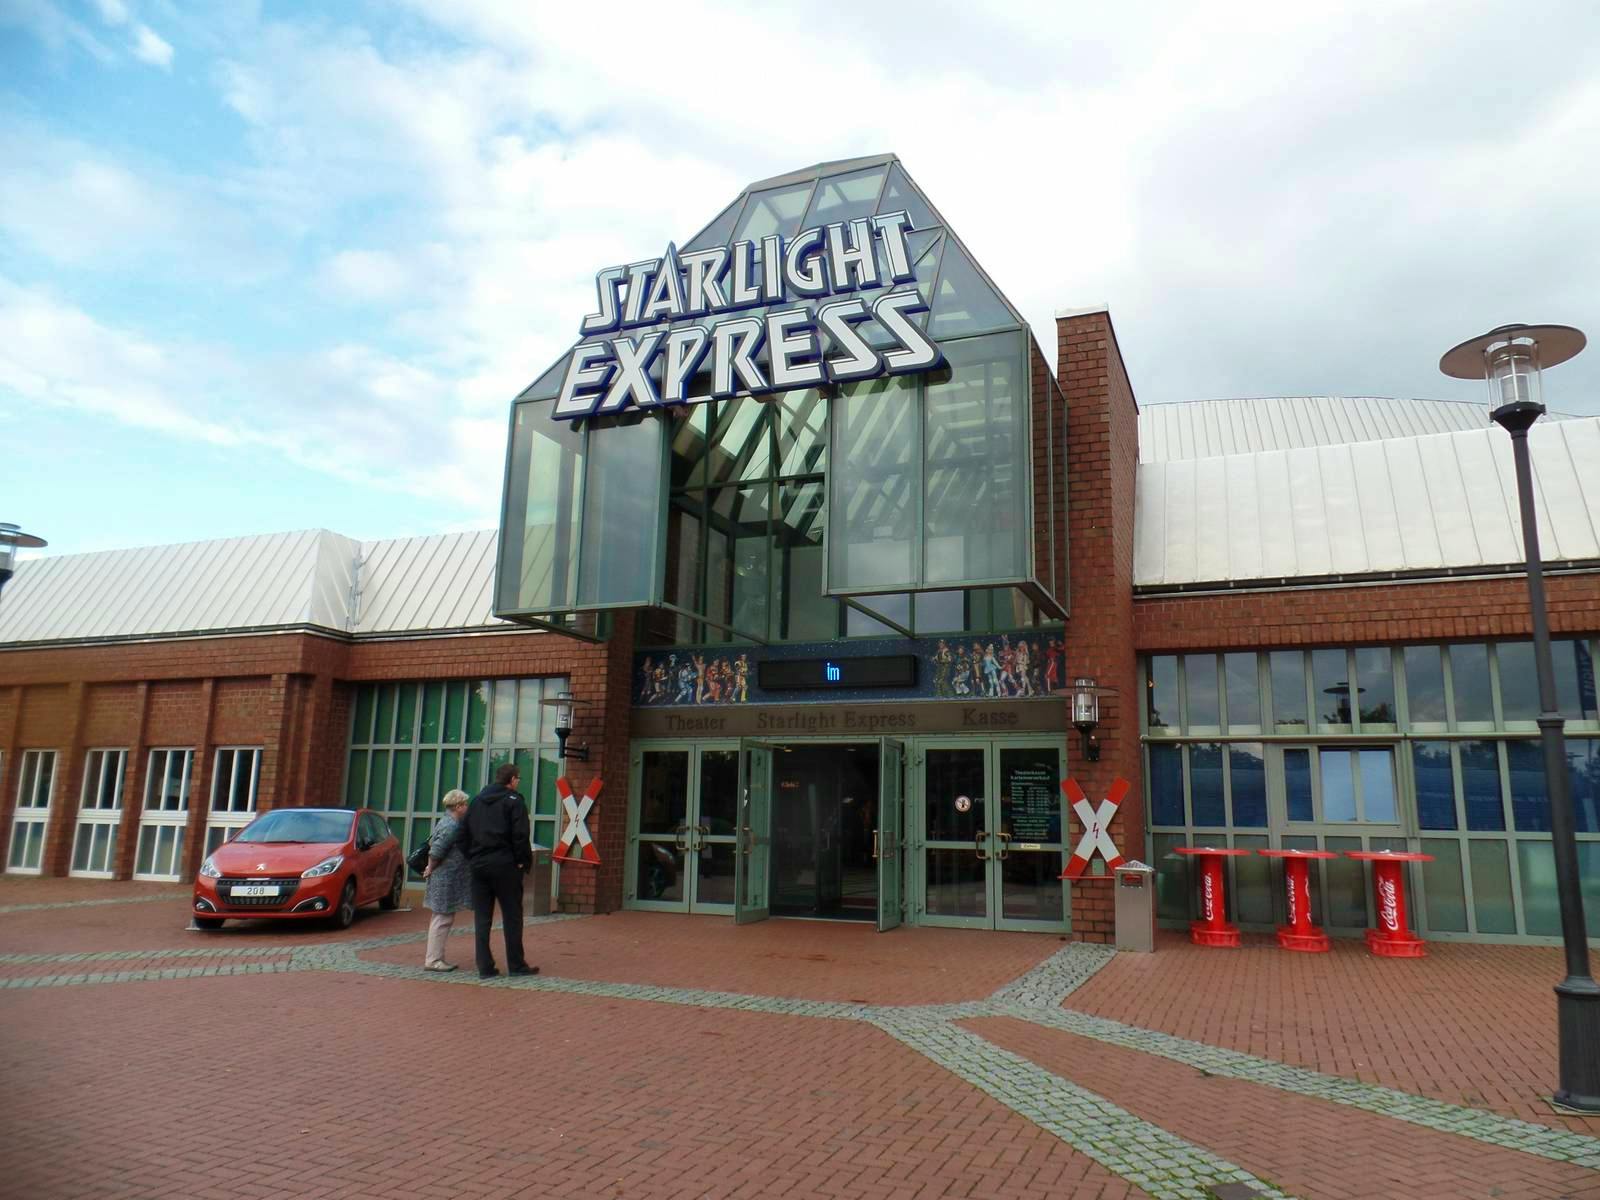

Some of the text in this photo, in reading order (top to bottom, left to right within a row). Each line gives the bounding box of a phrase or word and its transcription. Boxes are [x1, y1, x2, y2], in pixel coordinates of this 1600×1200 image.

[579, 208, 916, 336] STARLIGHT
[551, 290, 943, 421] EXPRESS
[665, 707, 1020, 733] Theater Starlight Express Kasse
[247, 887, 265, 895] 208
